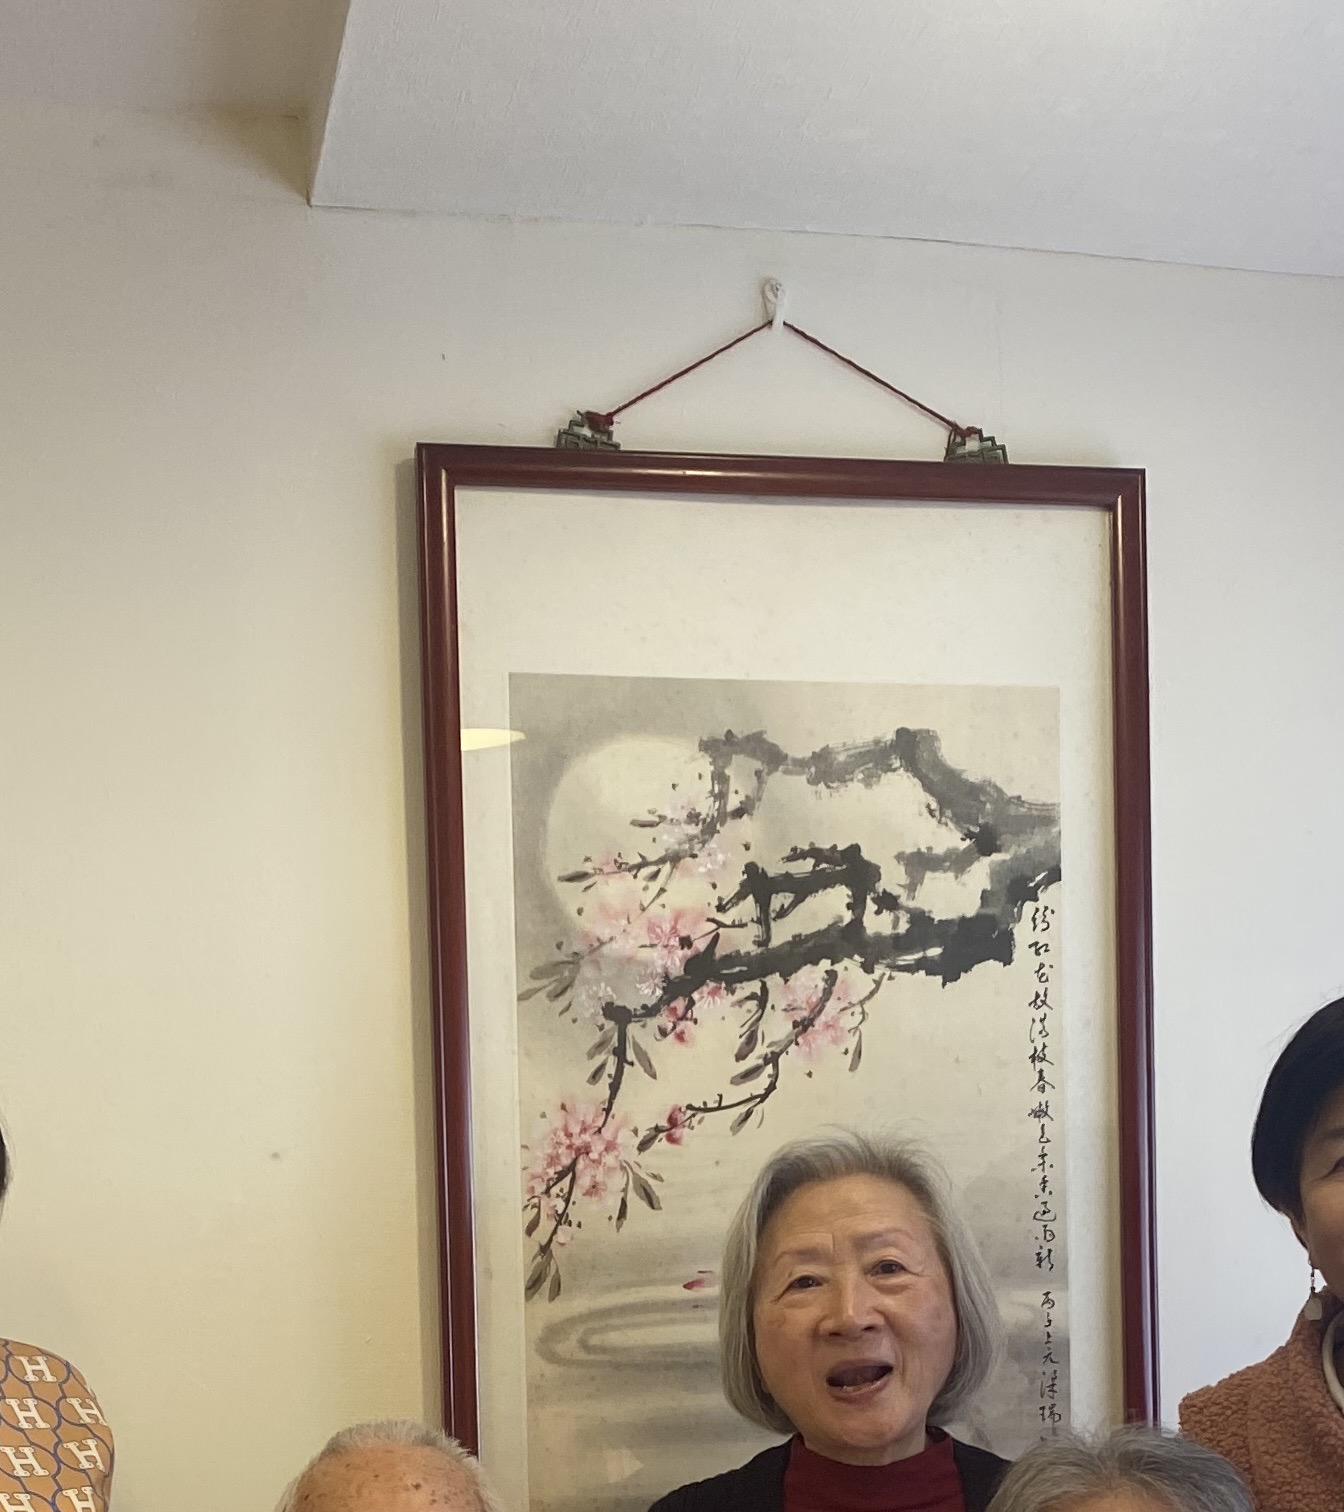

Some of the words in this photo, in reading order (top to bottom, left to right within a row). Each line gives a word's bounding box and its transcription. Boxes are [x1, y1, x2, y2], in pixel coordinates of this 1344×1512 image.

[13, 1355, 58, 1383] H
[3, 1396, 48, 1430] H
[0, 1444, 49, 1478] H
[64, 1438, 104, 1471] H
